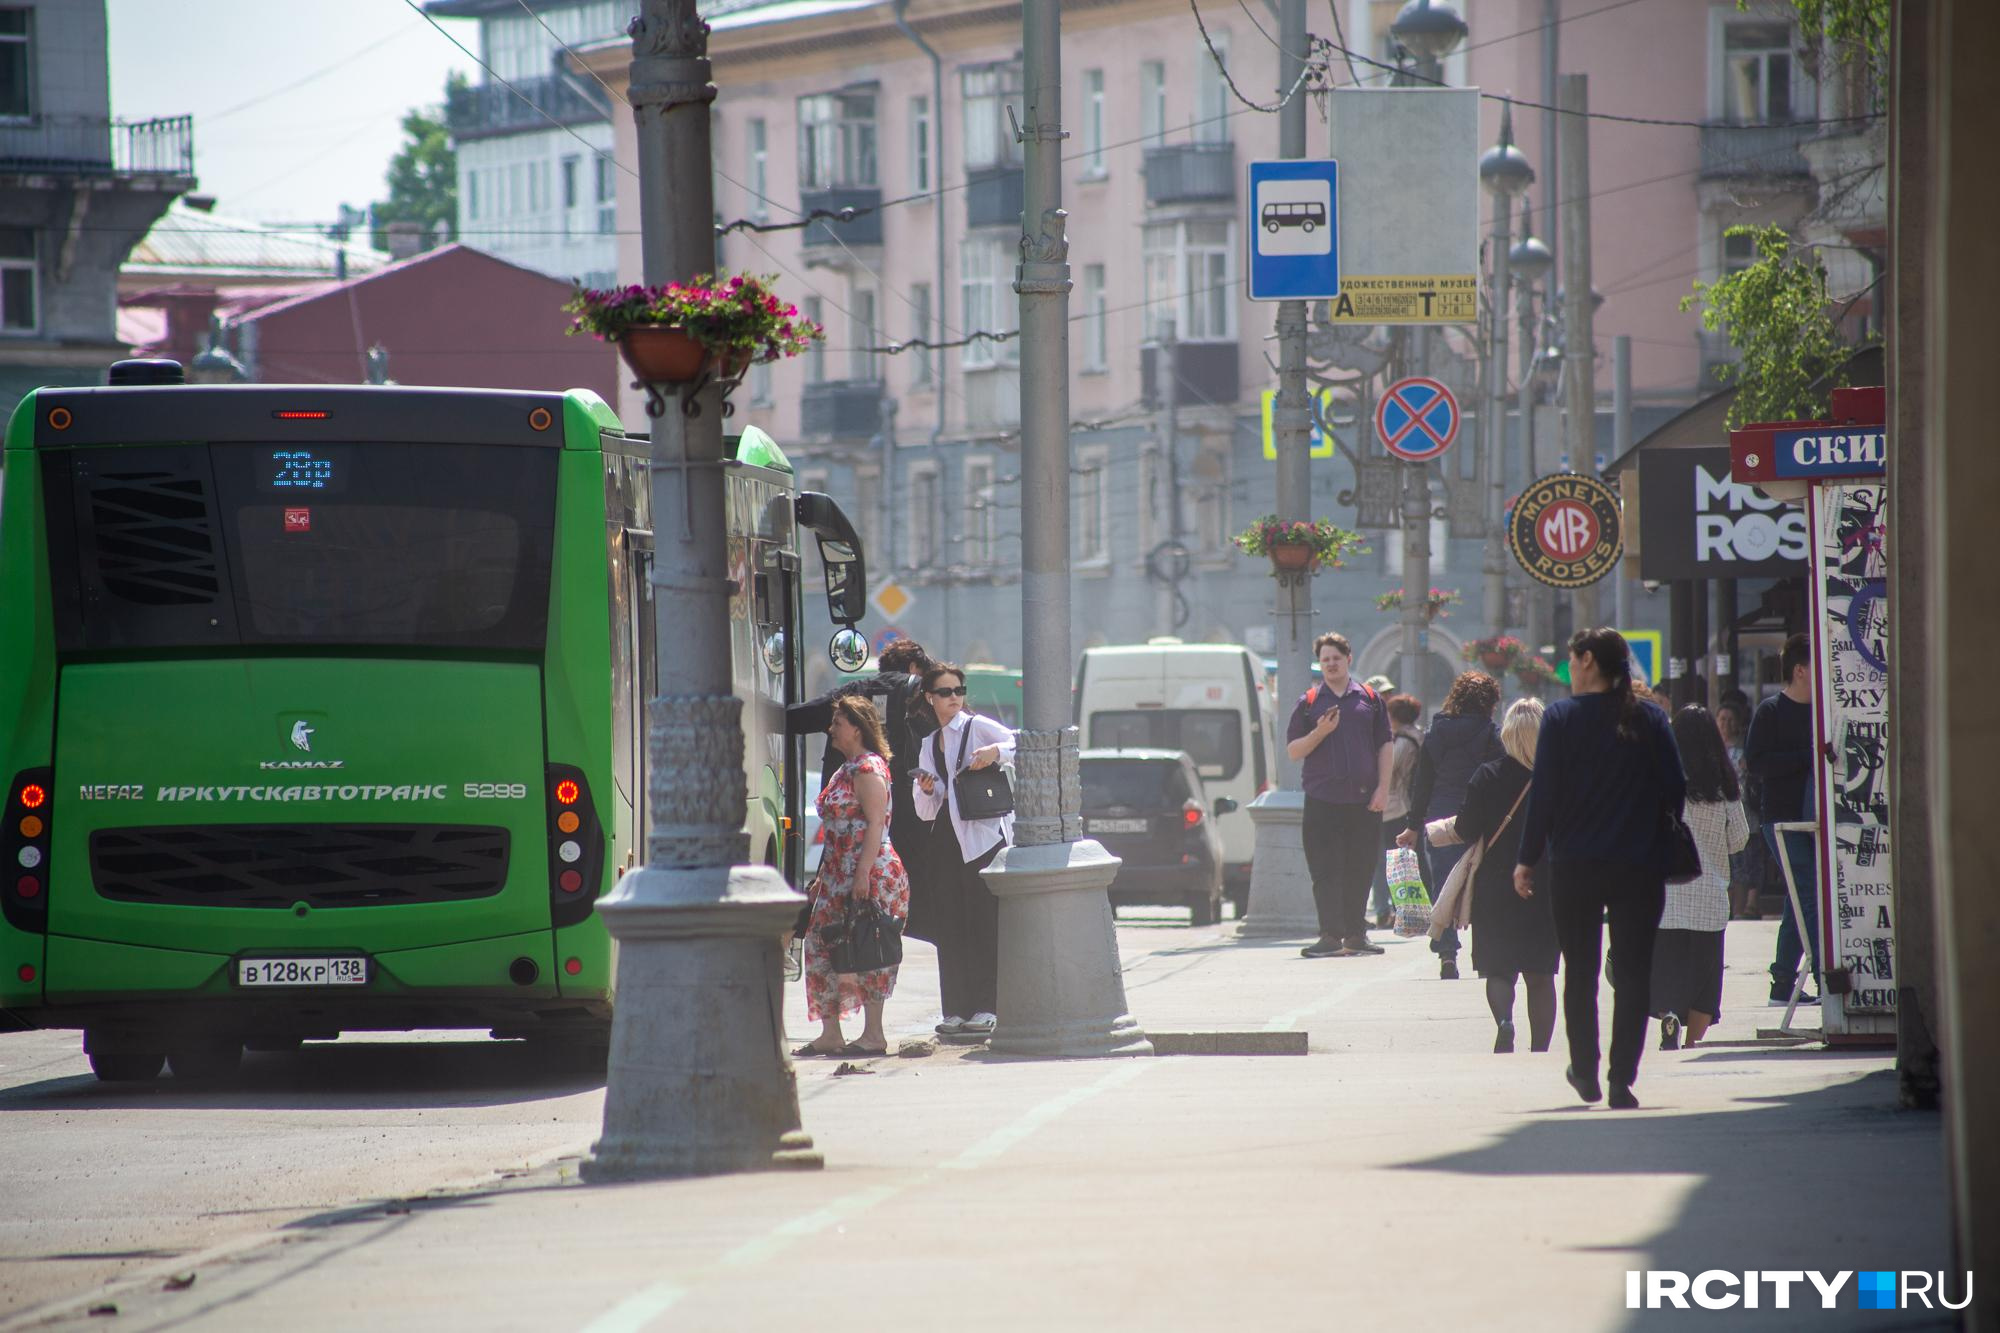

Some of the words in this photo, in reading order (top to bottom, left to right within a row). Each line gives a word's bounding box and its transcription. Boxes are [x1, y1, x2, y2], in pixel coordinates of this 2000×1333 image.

[1335, 293, 1354, 317] А
[1419, 292, 1436, 317] Т
[1523, 483, 1604, 520] MONEY
[1536, 541, 1611, 578] ROSES
[259, 760, 344, 769] KAMAZ
[79, 784, 144, 801] NEFAZ
[156, 784, 447, 802] ИРКУТСКАВТОТРАНС
[463, 783, 527, 799] 5299
[331, 960, 360, 976] 138
